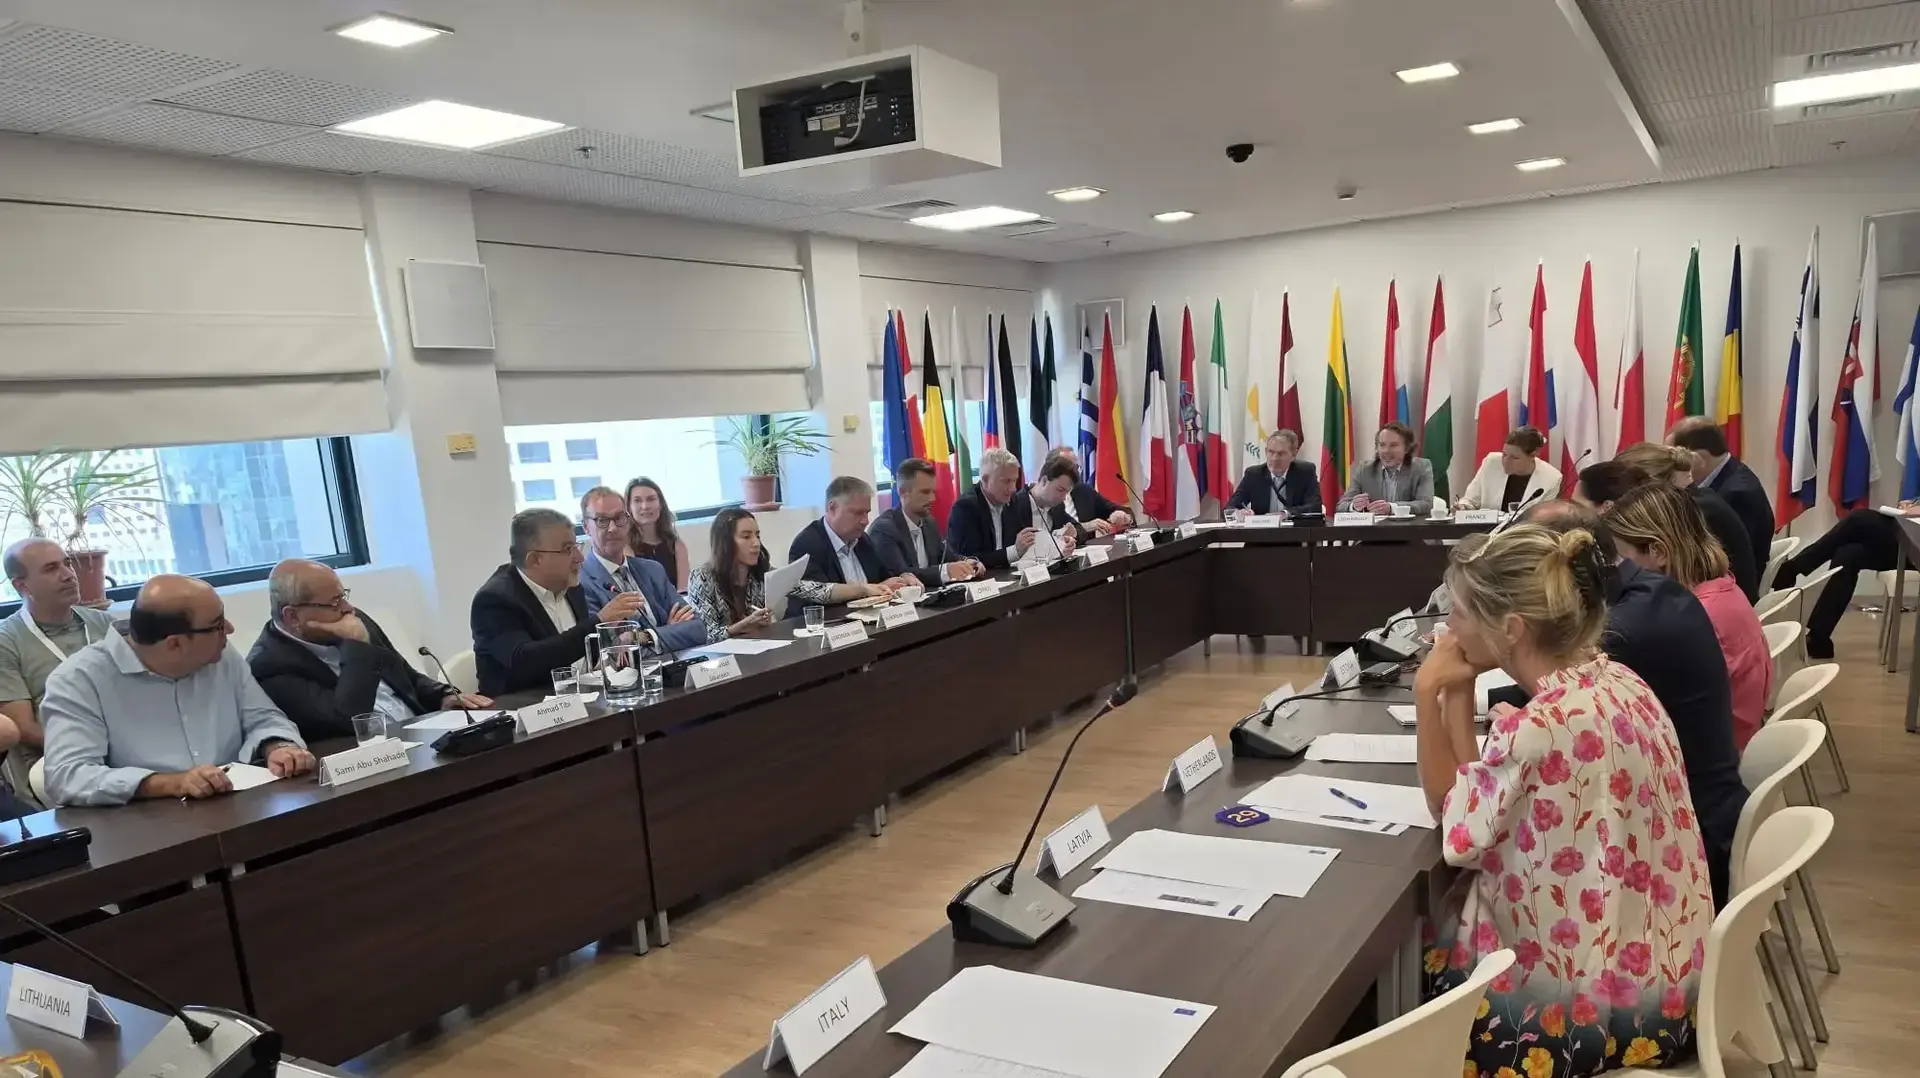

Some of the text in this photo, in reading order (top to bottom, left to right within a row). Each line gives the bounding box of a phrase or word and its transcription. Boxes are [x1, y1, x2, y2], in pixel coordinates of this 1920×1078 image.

[537, 701, 572, 716] Ahmad Tibi
[553, 716, 565, 725] MK
[334, 765, 356, 777] Sami
[357, 760, 373, 770] Abu
[1182, 749, 1217, 779] NETHERLANDS
[1227, 810, 1260, 823] 29
[1067, 829, 1093, 854] LATVIA
[19, 987, 71, 1017] LITHUANIA
[817, 996, 850, 1033] ITALY
